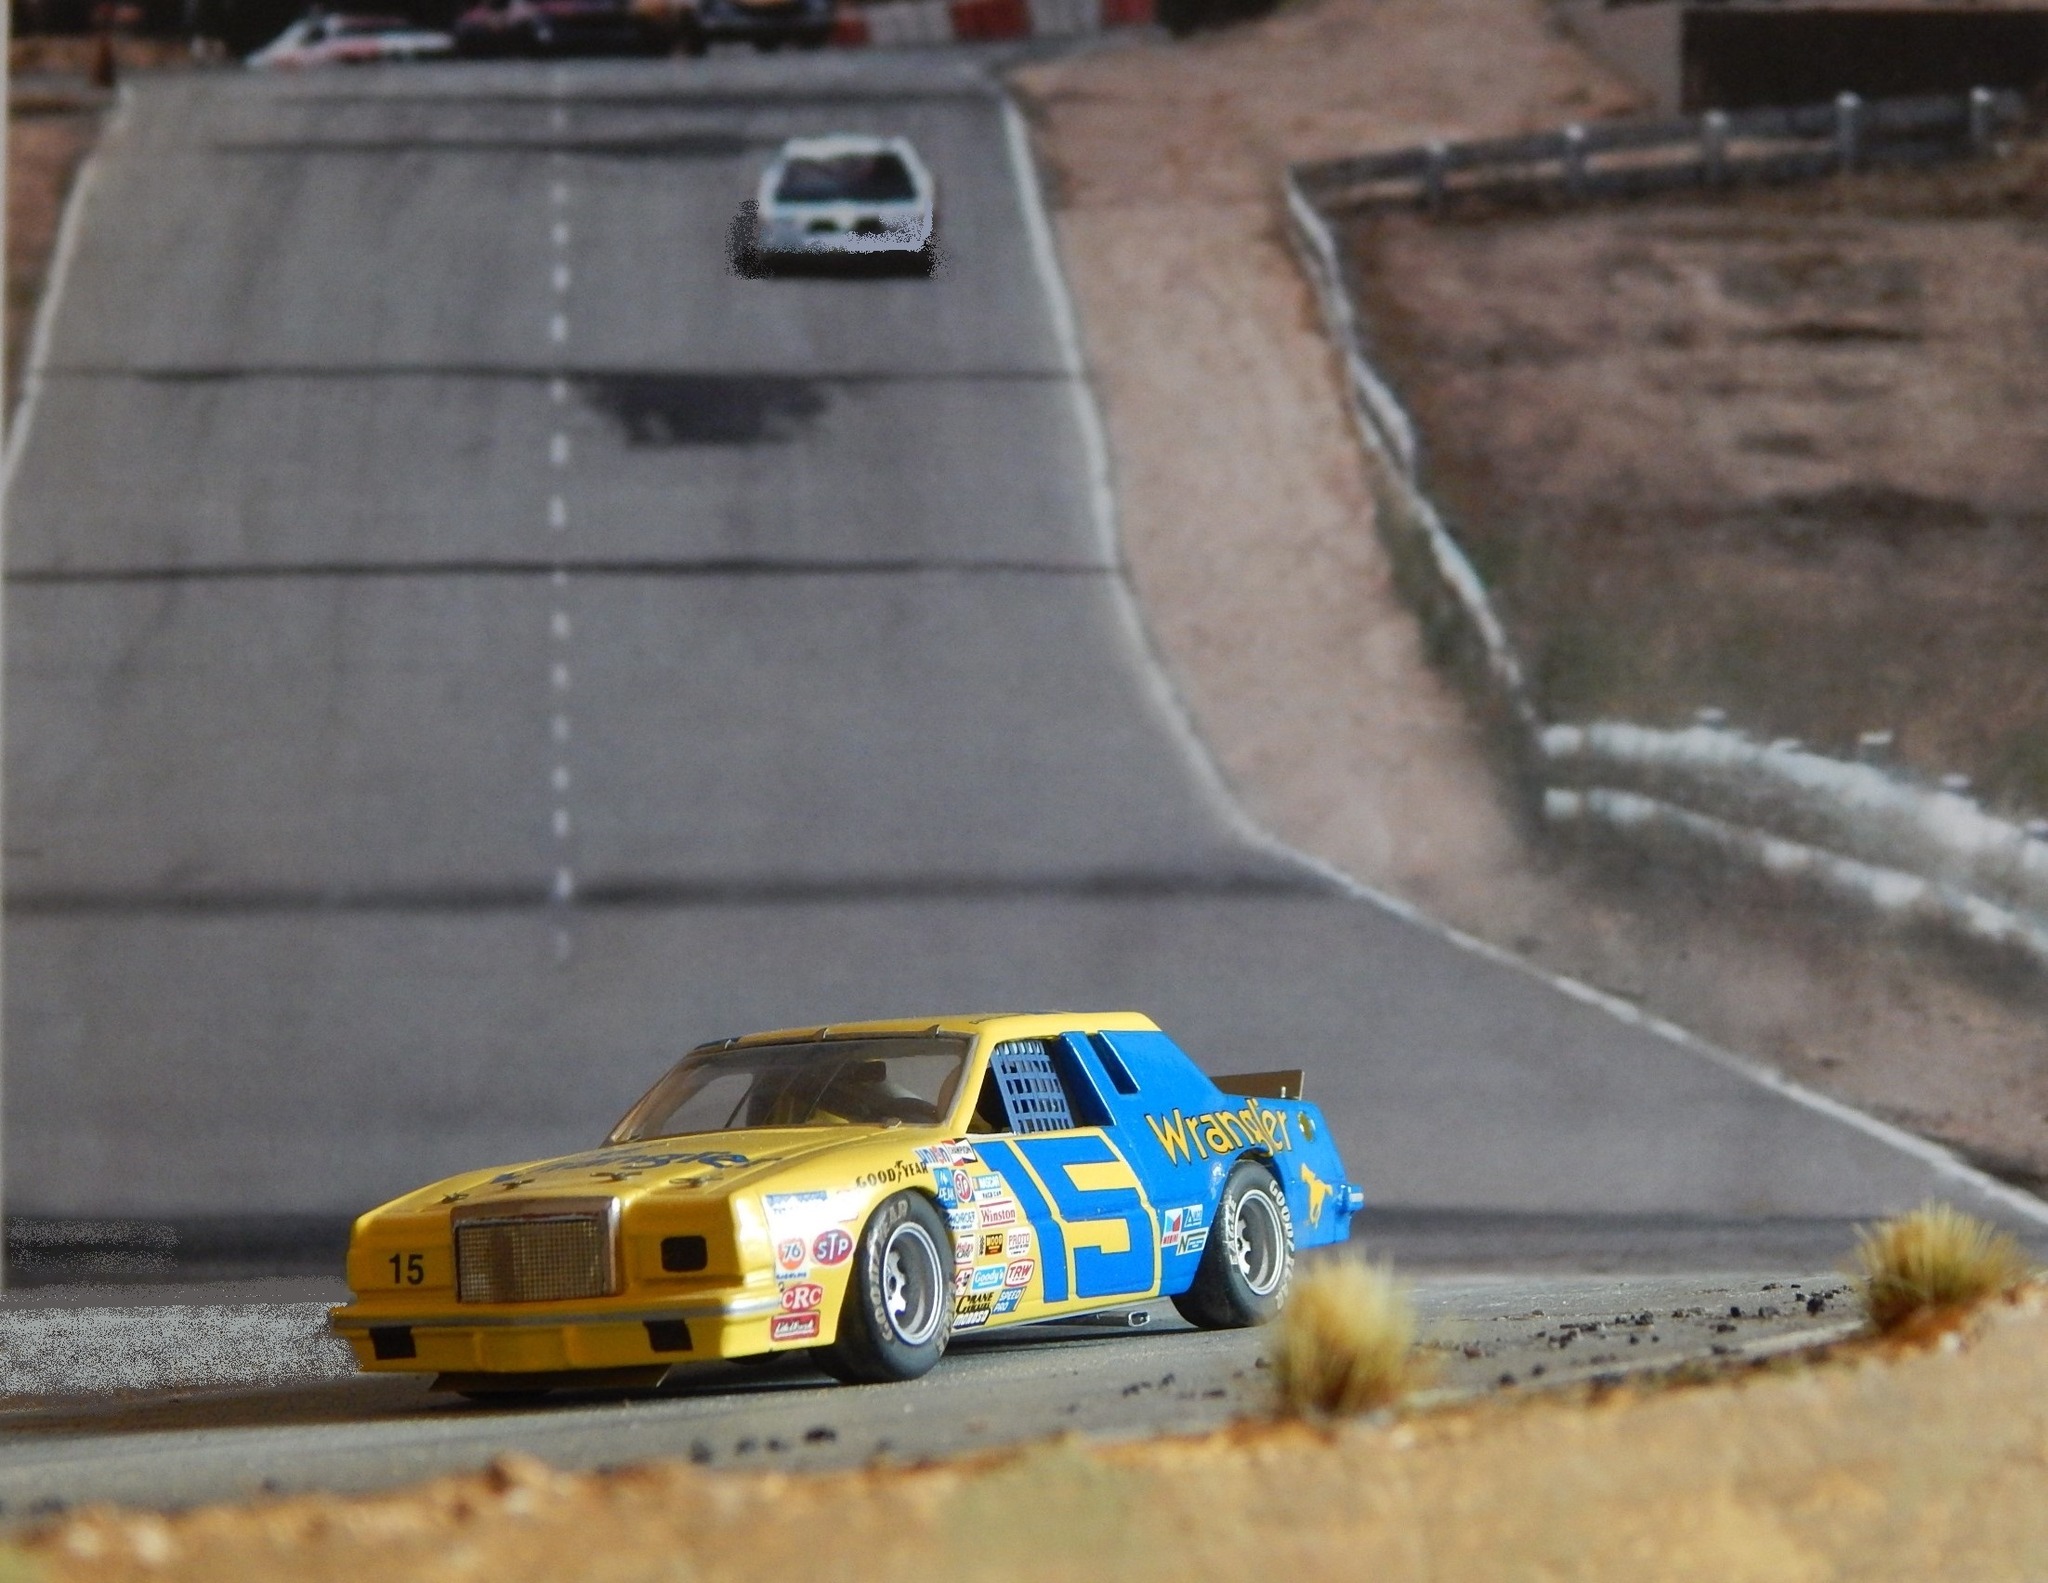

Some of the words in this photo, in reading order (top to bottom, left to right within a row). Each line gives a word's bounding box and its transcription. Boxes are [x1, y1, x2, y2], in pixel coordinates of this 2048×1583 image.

[1144, 1097, 1292, 1167] Wrangler
[856, 1160, 928, 1188] GOODYEAR
[955, 1172, 971, 1197] STP
[973, 1136, 1155, 1303] 15
[980, 1208, 1016, 1223] Winston
[816, 1233, 849, 1260] STP
[986, 1234, 1003, 1247] MOOG
[1008, 1233, 1030, 1247] PROTO
[784, 1244, 801, 1260] 76
[388, 1254, 424, 1285] 15
[975, 1266, 1003, 1284] Goody's
[1009, 1264, 1032, 1278] TRW
[782, 1287, 822, 1310] CRC
[1001, 1290, 1021, 1301] SPEED
[994, 1302, 1009, 1313] PRO
